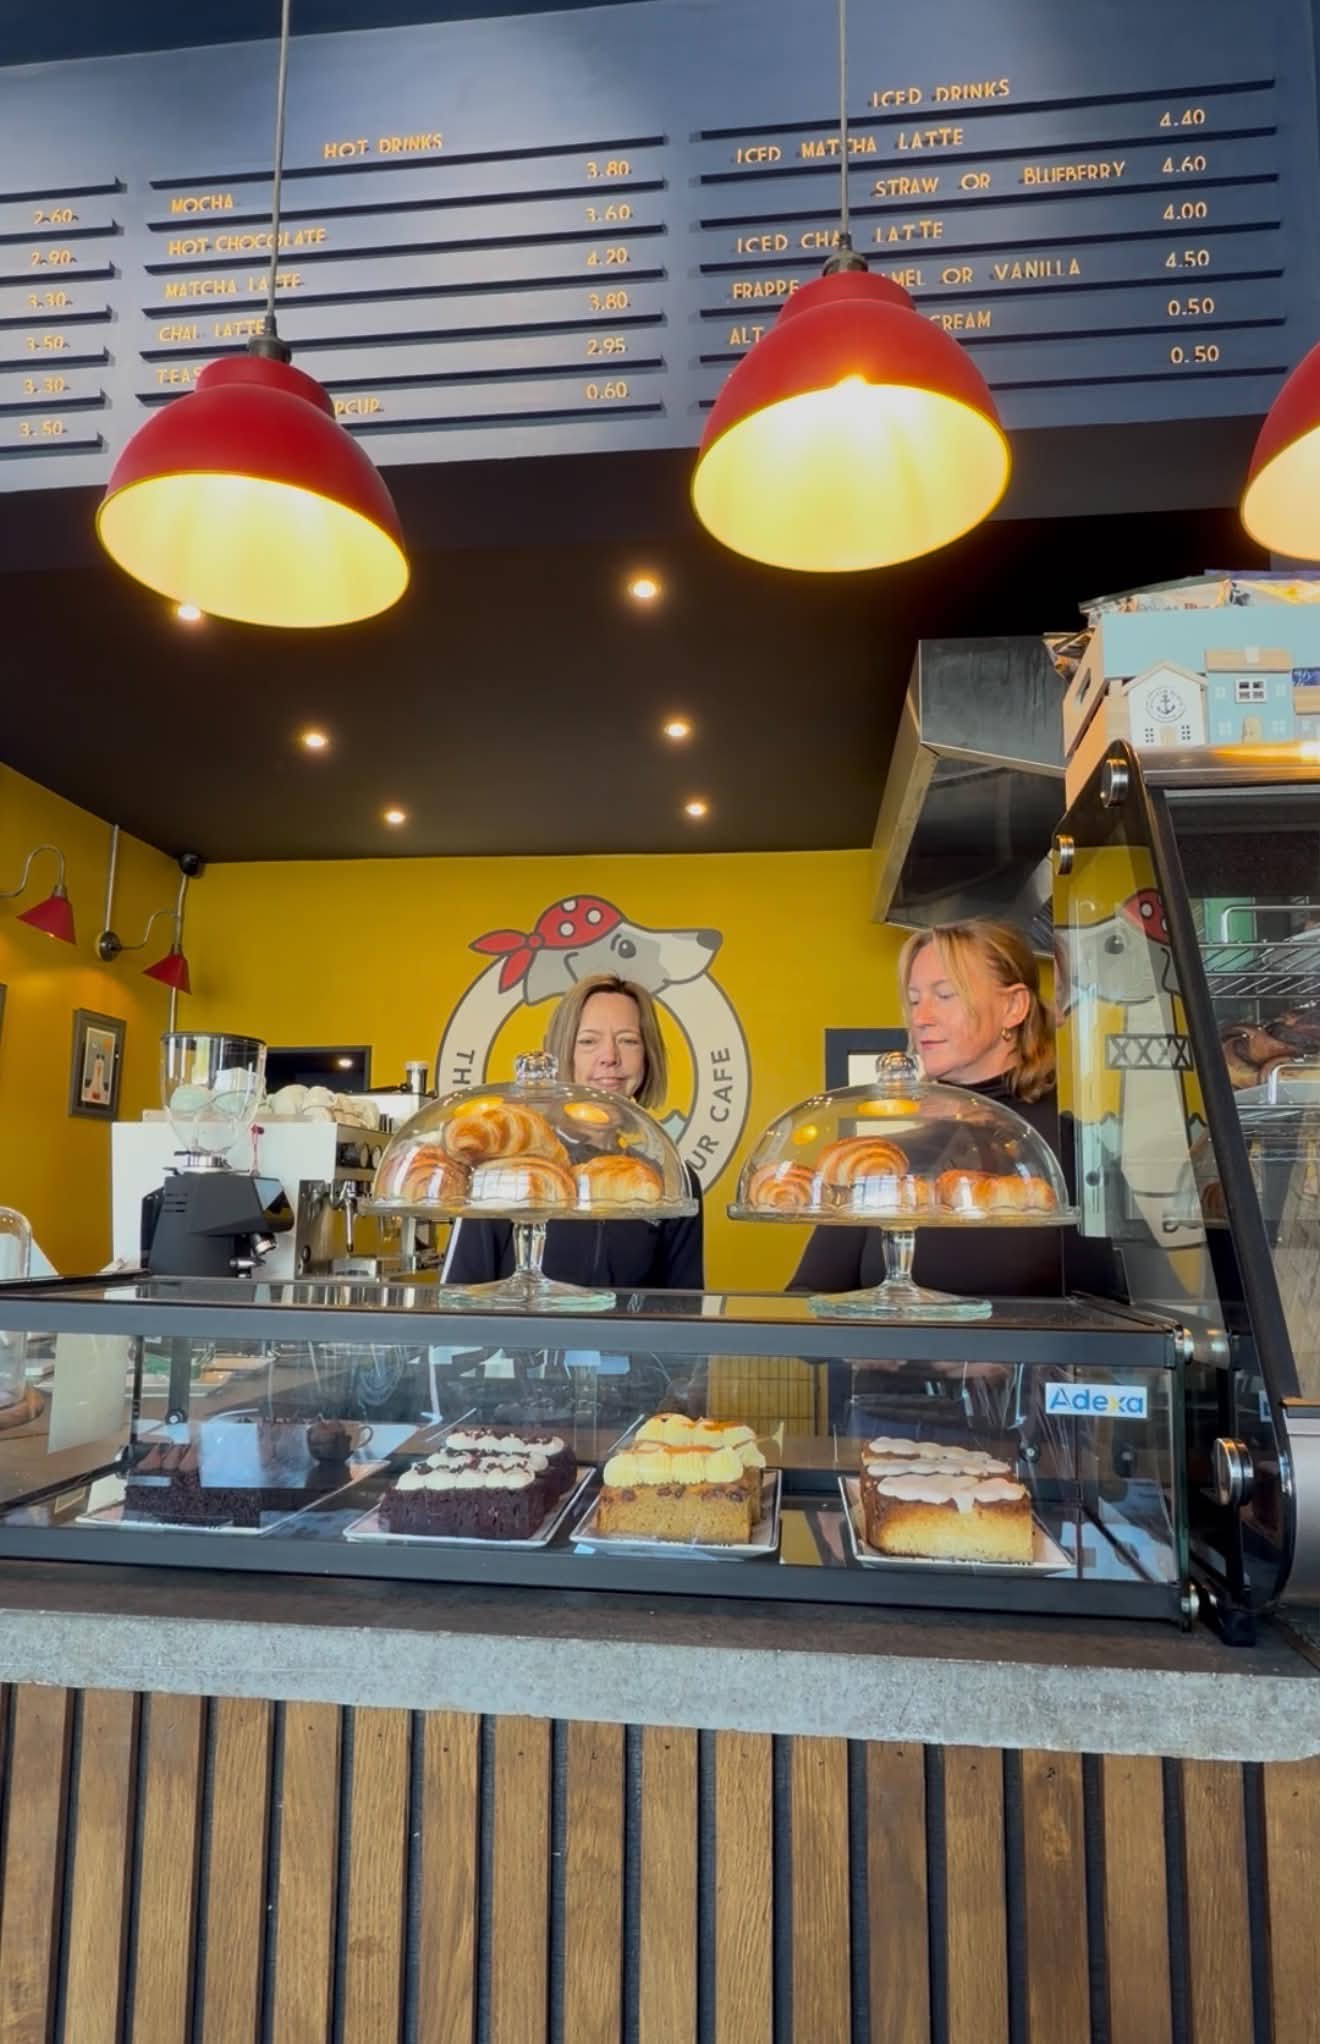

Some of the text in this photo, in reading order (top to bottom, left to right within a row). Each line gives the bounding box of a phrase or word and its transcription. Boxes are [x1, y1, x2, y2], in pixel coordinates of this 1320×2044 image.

[872, 79, 1010, 108] ICED DRINKS
[324, 133, 442, 158] HOT DRINKS
[736, 147, 781, 163] ICED
[898, 127, 963, 150] LATTE
[1159, 109, 1206, 127] 4.40
[171, 160, 630, 214] MOCHA 3.80
[875, 155, 1207, 196] STRAW OR BLUEBERRY 4.60
[33, 208, 73, 225] 2.60
[168, 205, 631, 256] HOT CHOCOLATE 3.60
[736, 202, 1207, 253] ICED CHA LATTE 4.00
[31, 249, 71, 265] 2.90
[165, 279, 237, 300] MATCHA
[587, 248, 628, 267] 4.20
[891, 268, 926, 289] MEL
[942, 266, 973, 284] OR
[993, 257, 1080, 281] VANILLA
[1164, 249, 1210, 268] 4.50
[159, 291, 628, 342] CHAI LATTE 3.80
[1168, 297, 1215, 316] 0.50
[587, 337, 625, 356] 2.95
[1170, 345, 1219, 364] 0.50
[334, 381, 628, 416] PCUP 0.60
[452, 1049, 475, 1085] TH
[684, 1047, 734, 1171] UR CAFE
[1049, 1386, 1144, 1414] Adexa
